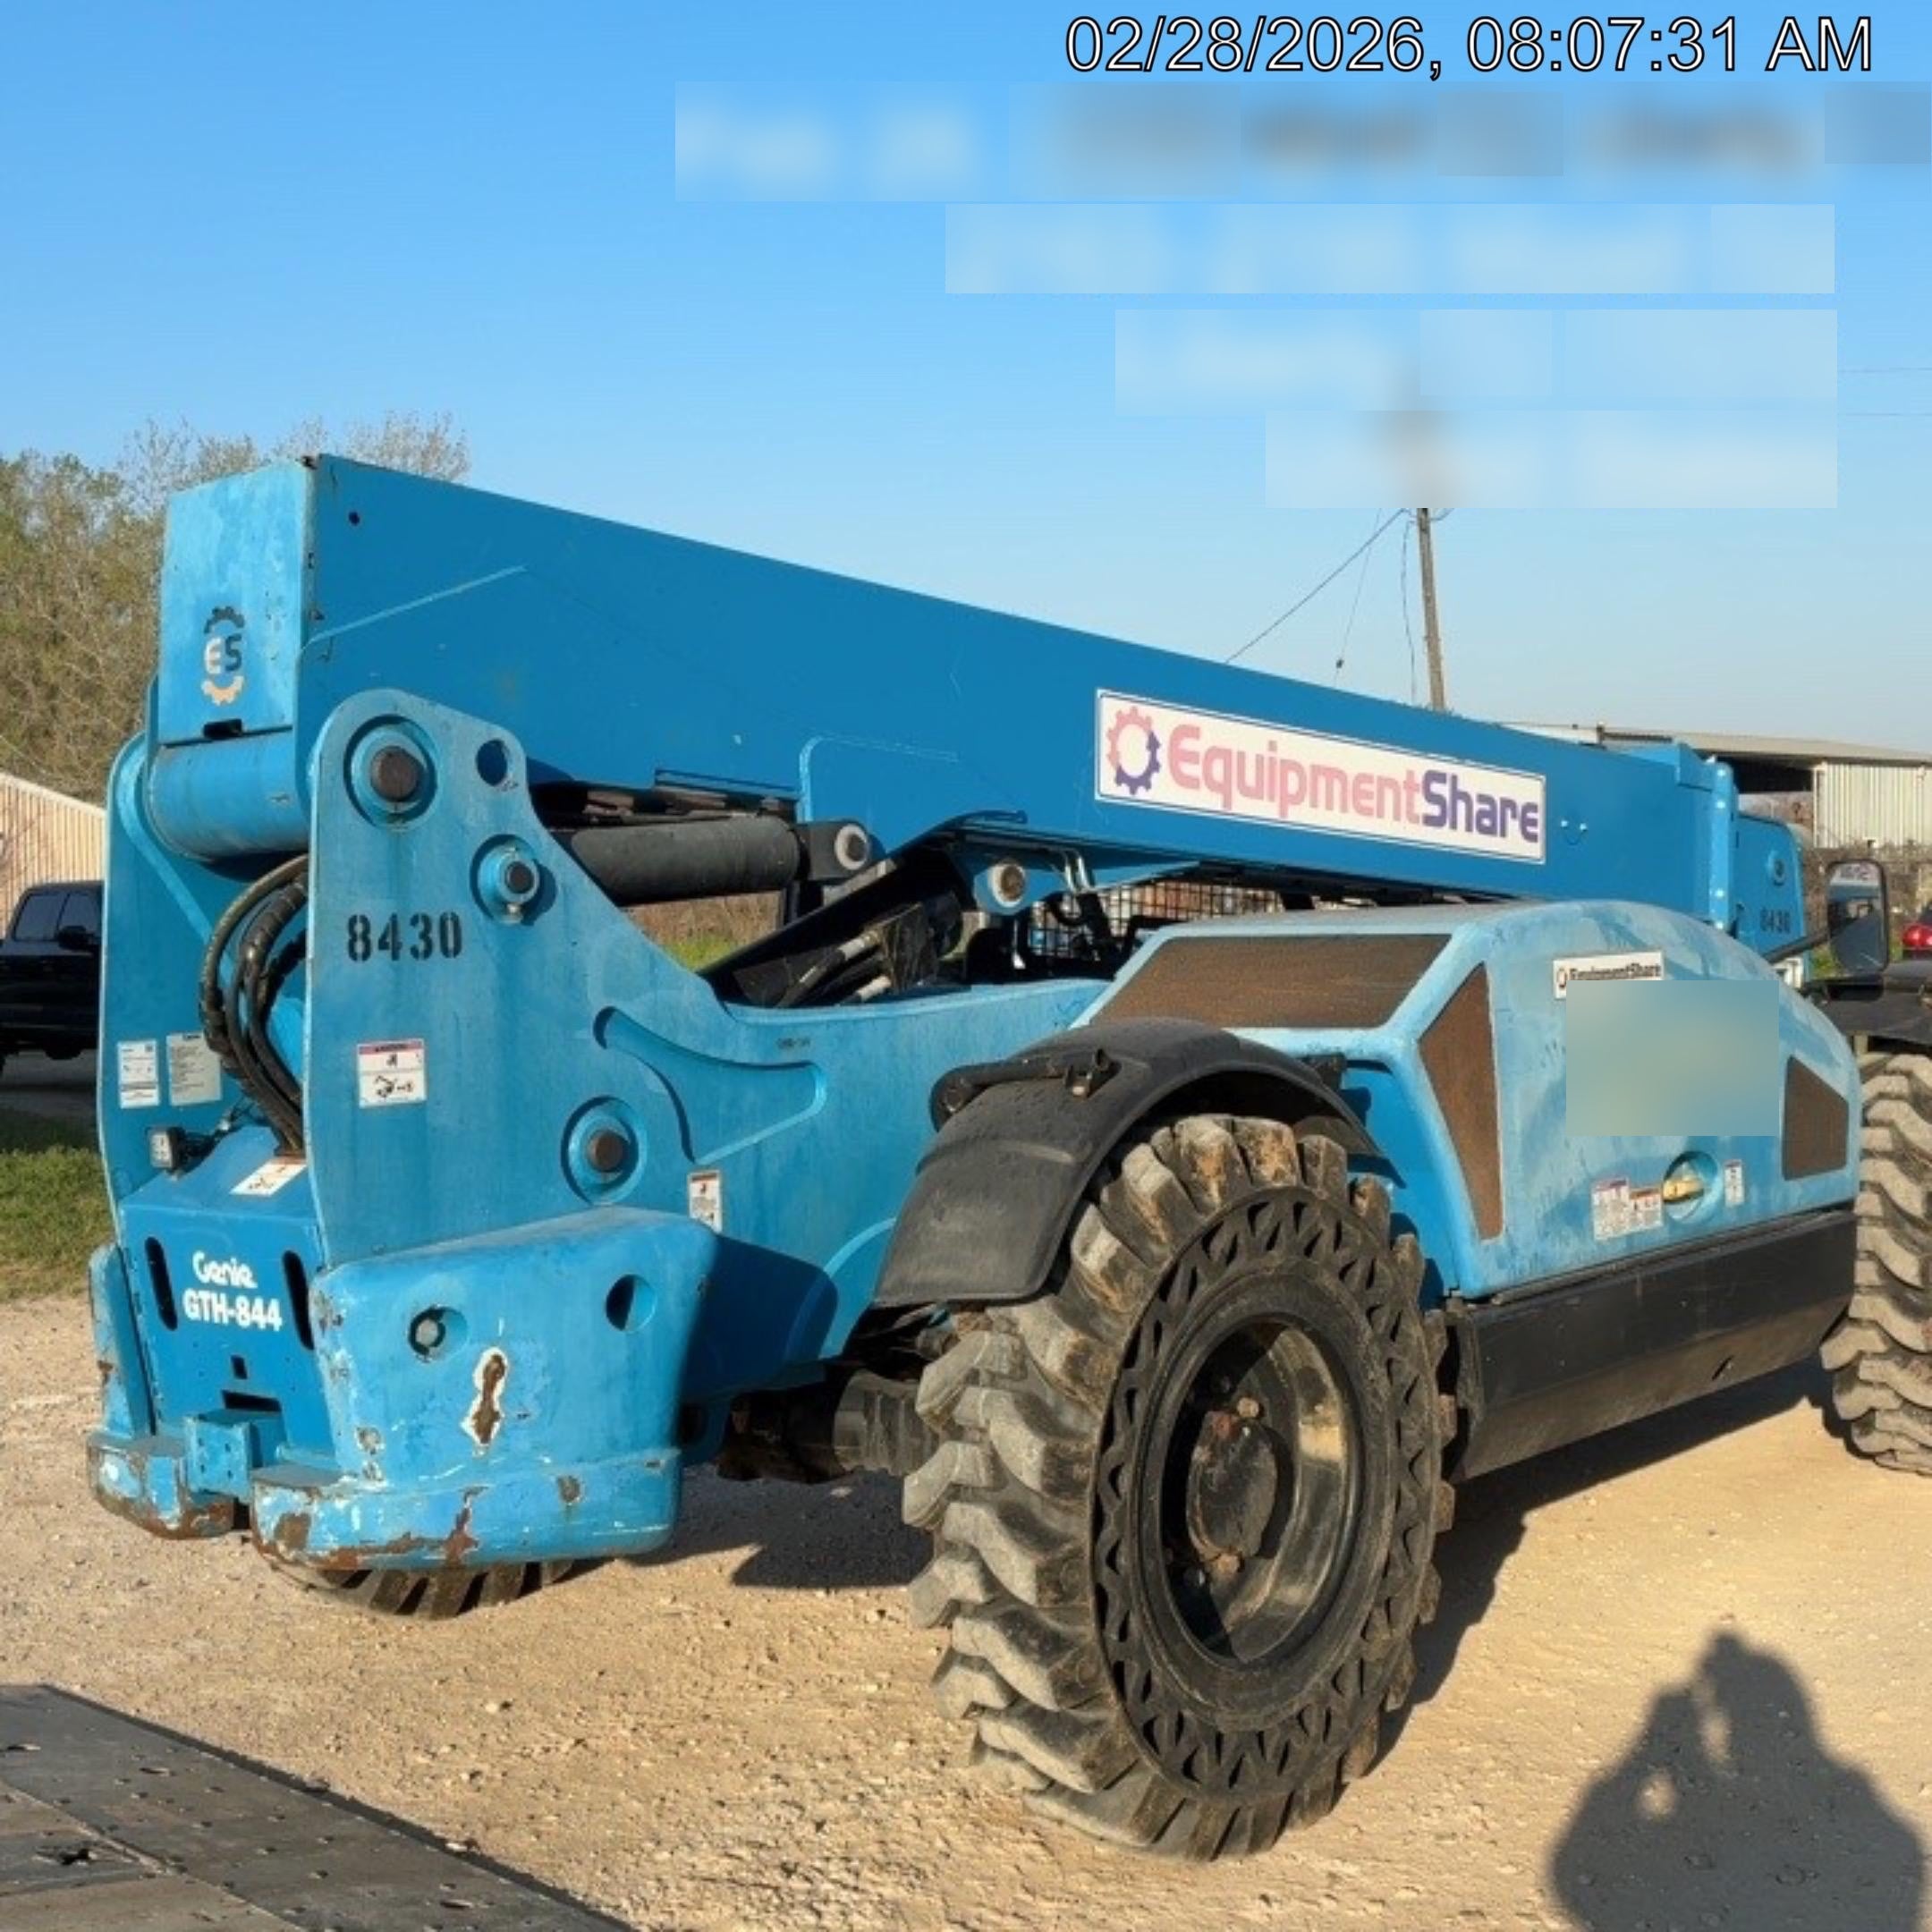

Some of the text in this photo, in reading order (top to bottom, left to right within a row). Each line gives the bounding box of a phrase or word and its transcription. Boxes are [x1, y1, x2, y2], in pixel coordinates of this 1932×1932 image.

[203, 632, 243, 674] ES
[1167, 723, 1539, 843] EquipmentShare
[347, 911, 463, 962] 8430
[191, 1250, 258, 1289] Genie
[182, 1287, 284, 1332] GTH-844
